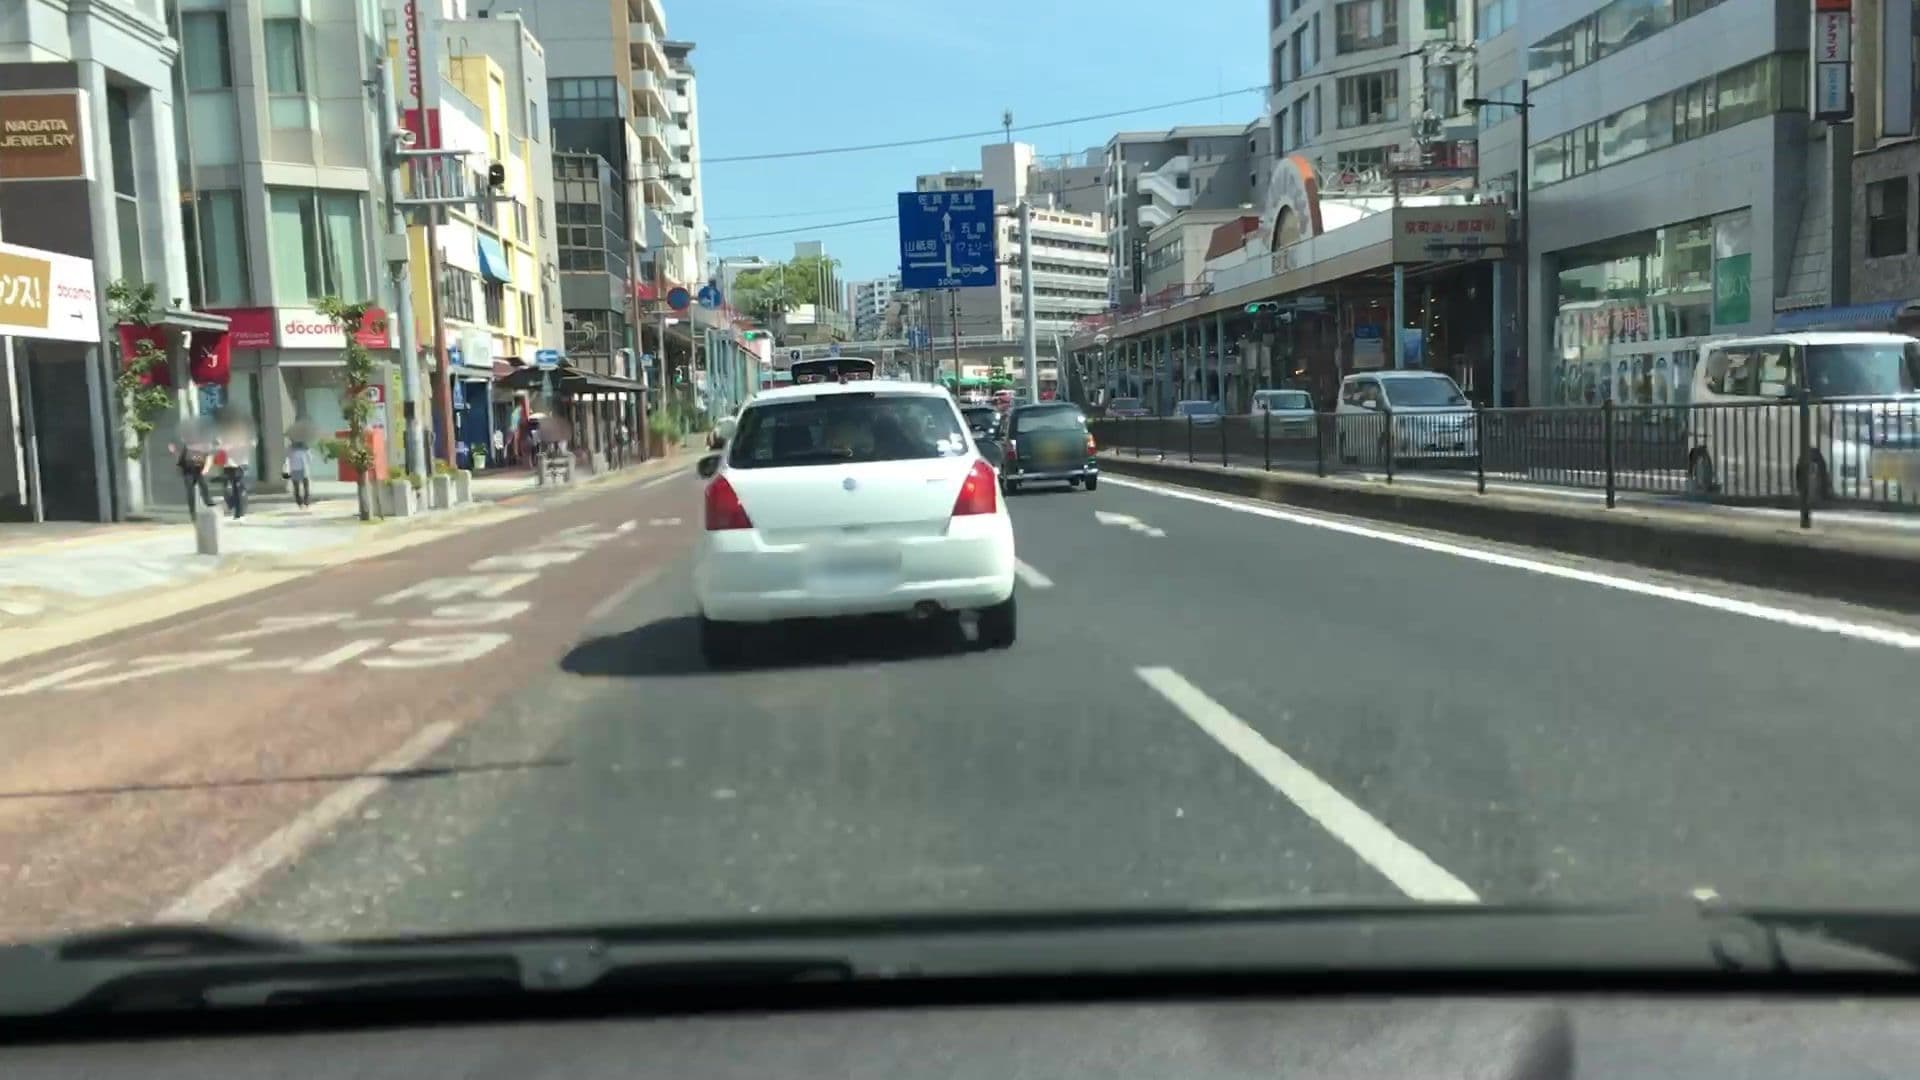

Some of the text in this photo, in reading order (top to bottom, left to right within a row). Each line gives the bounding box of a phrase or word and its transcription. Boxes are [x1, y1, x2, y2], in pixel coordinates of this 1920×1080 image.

[5, 120, 68, 132] NAGATA
[0, 134, 74, 147] JEWELRY
[961, 222, 986, 233] 五
[0, 274, 42, 309] ンス!
